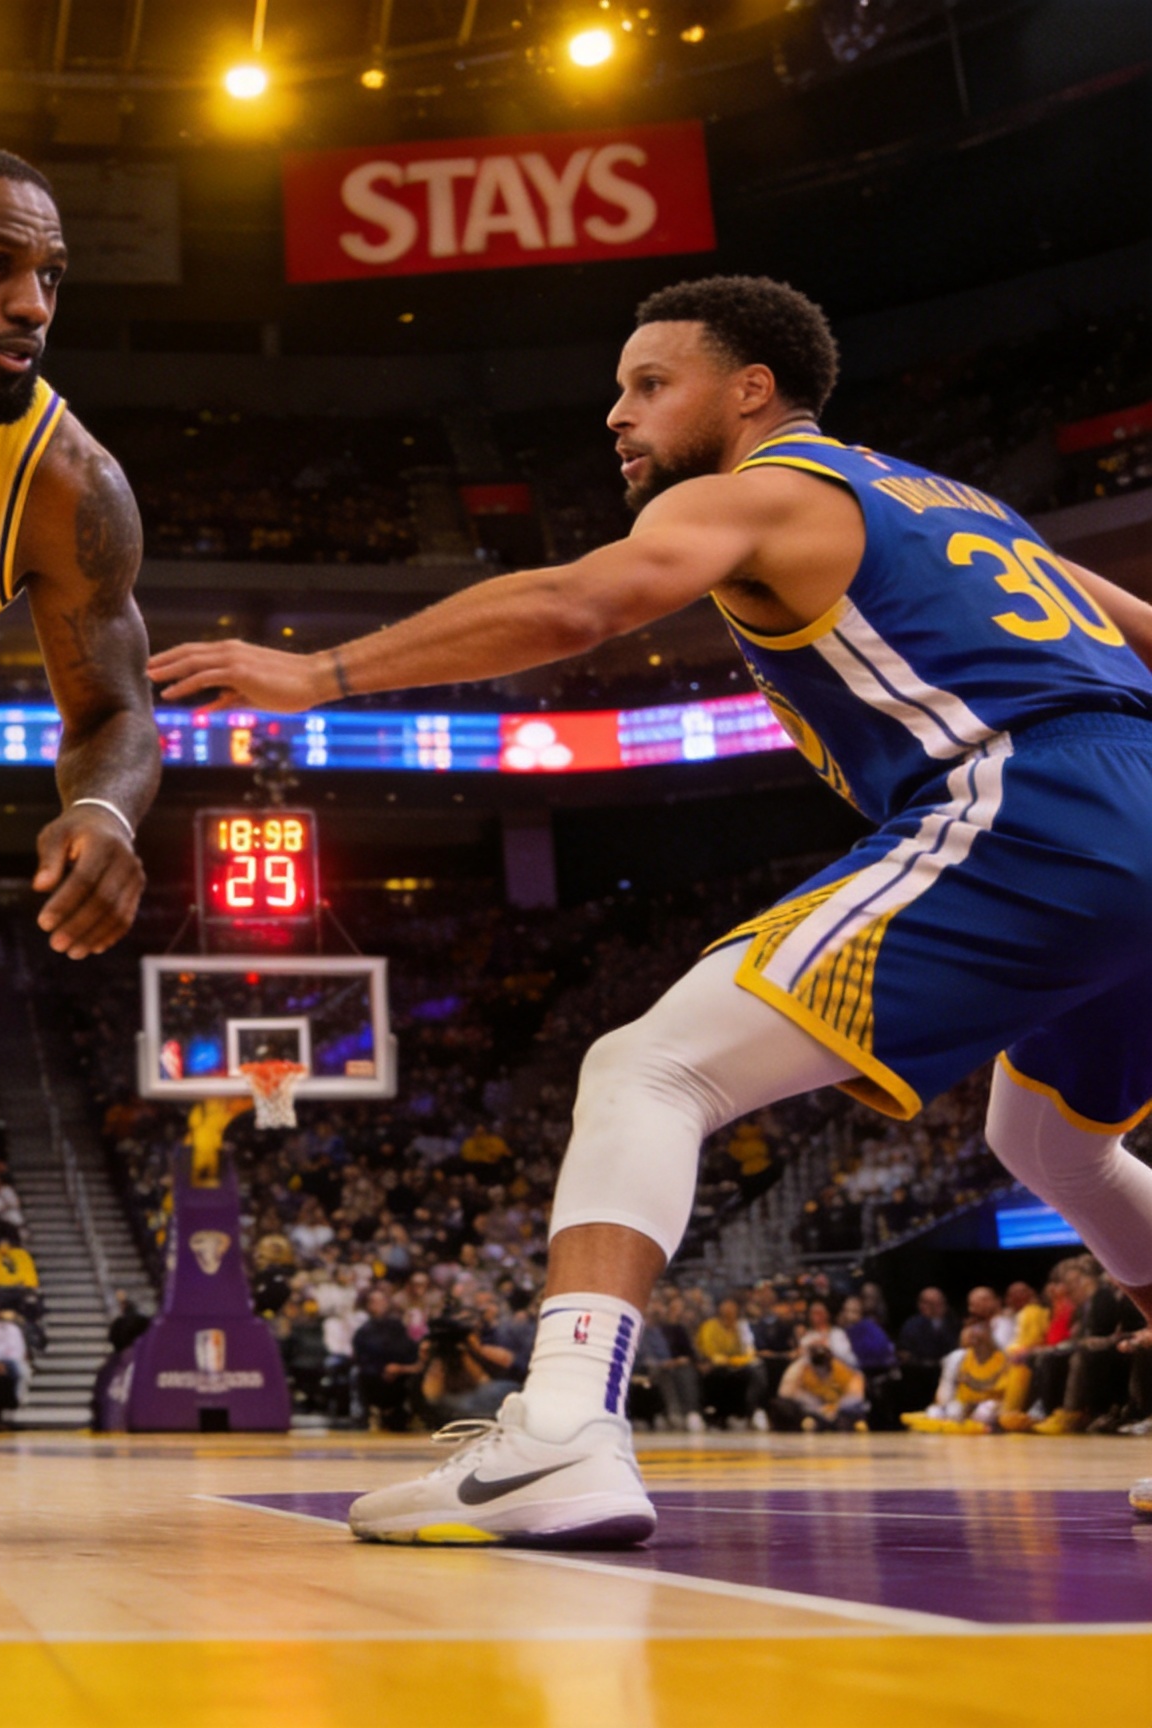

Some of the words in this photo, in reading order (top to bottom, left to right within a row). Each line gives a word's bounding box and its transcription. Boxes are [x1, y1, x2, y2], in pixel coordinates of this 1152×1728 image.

[339, 143, 657, 264] STAYS
[947, 532, 1126, 646] 30
[226, 855, 296, 907] 29
